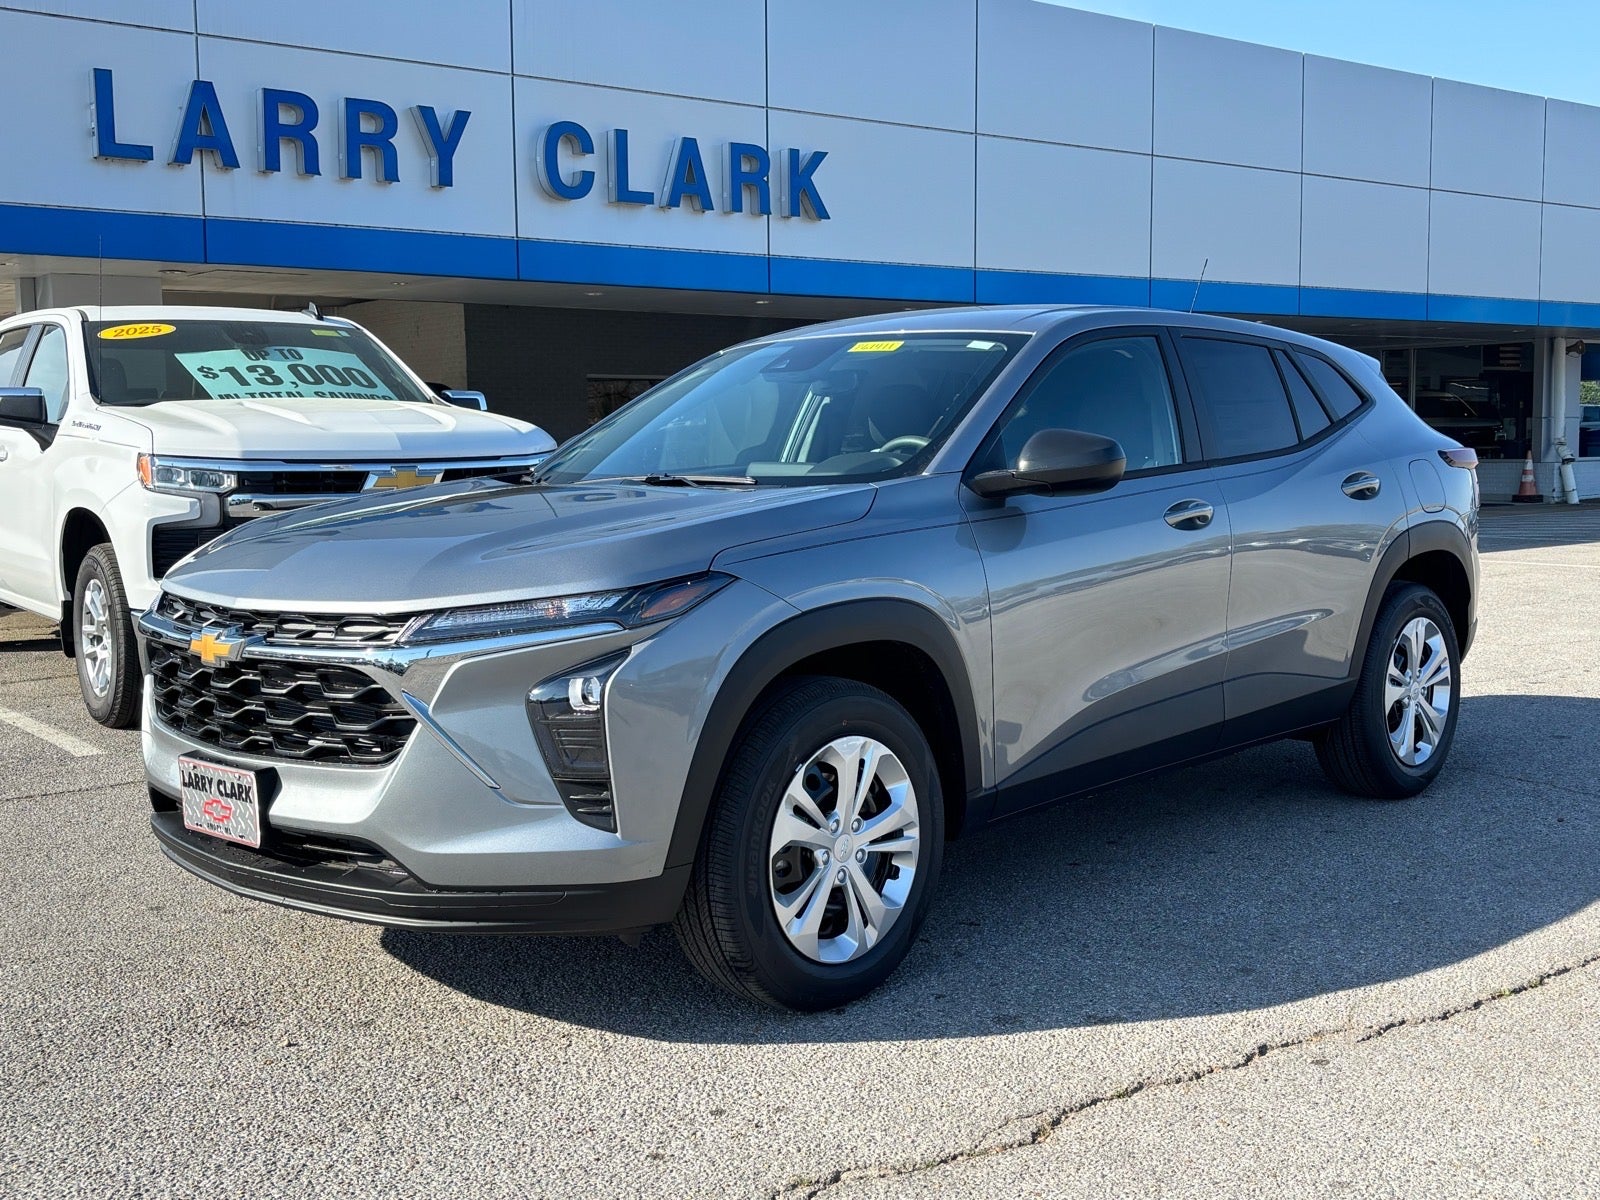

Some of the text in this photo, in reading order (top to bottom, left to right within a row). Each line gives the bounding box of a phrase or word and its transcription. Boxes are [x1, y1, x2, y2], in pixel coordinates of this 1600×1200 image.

[91, 68, 831, 220] LARRY CLARK
[113, 325, 162, 337] 2025
[242, 349, 304, 361] UP TO
[197, 364, 378, 389] $13,000
[181, 769, 253, 804] LARRY CLARK
